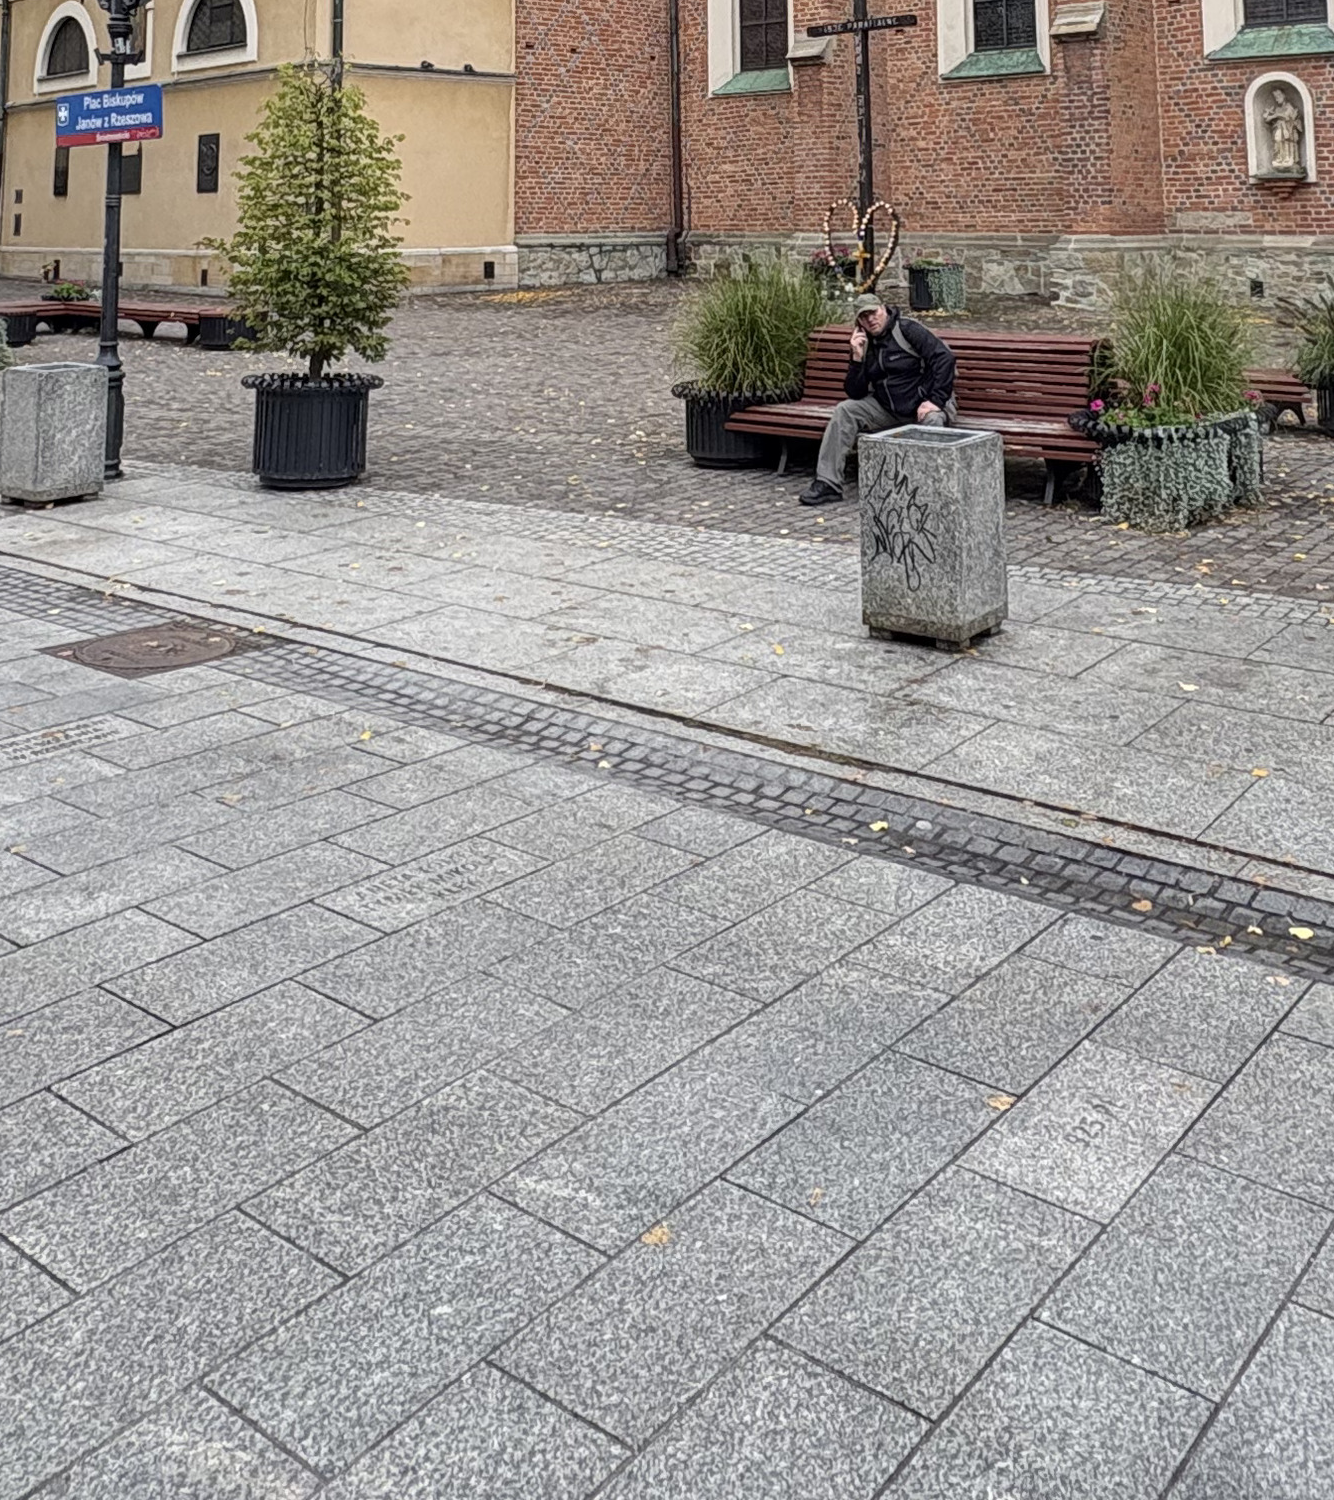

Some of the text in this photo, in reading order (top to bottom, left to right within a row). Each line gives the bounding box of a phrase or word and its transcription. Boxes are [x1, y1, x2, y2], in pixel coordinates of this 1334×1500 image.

[83, 91, 144, 110] Plac Biskupów
[75, 112, 152, 130] Janów z Rzeszowa
